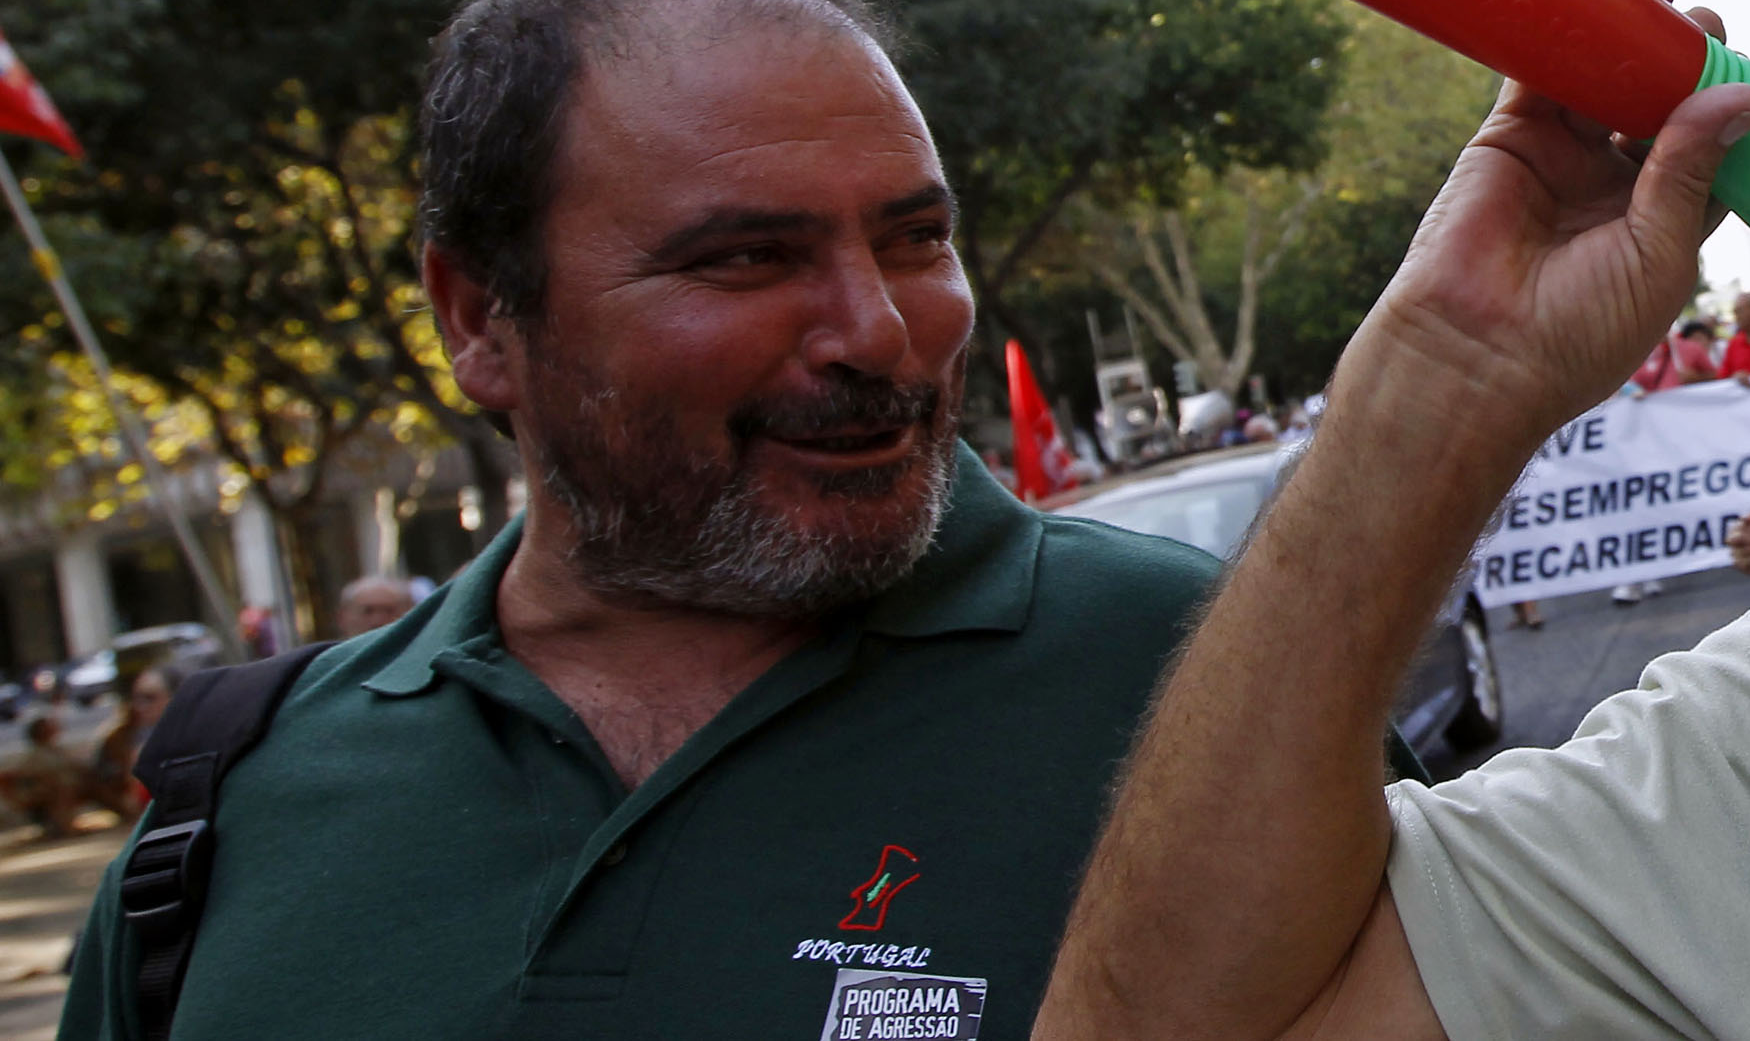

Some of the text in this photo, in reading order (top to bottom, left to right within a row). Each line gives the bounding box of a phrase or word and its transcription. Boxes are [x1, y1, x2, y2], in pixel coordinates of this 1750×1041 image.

[1538, 417, 1606, 458] VE
[793, 939, 931, 968] PORTUGAL
[843, 987, 960, 1016] PROGRAMA
[839, 1016, 959, 1040] DE AGRESSÃO
